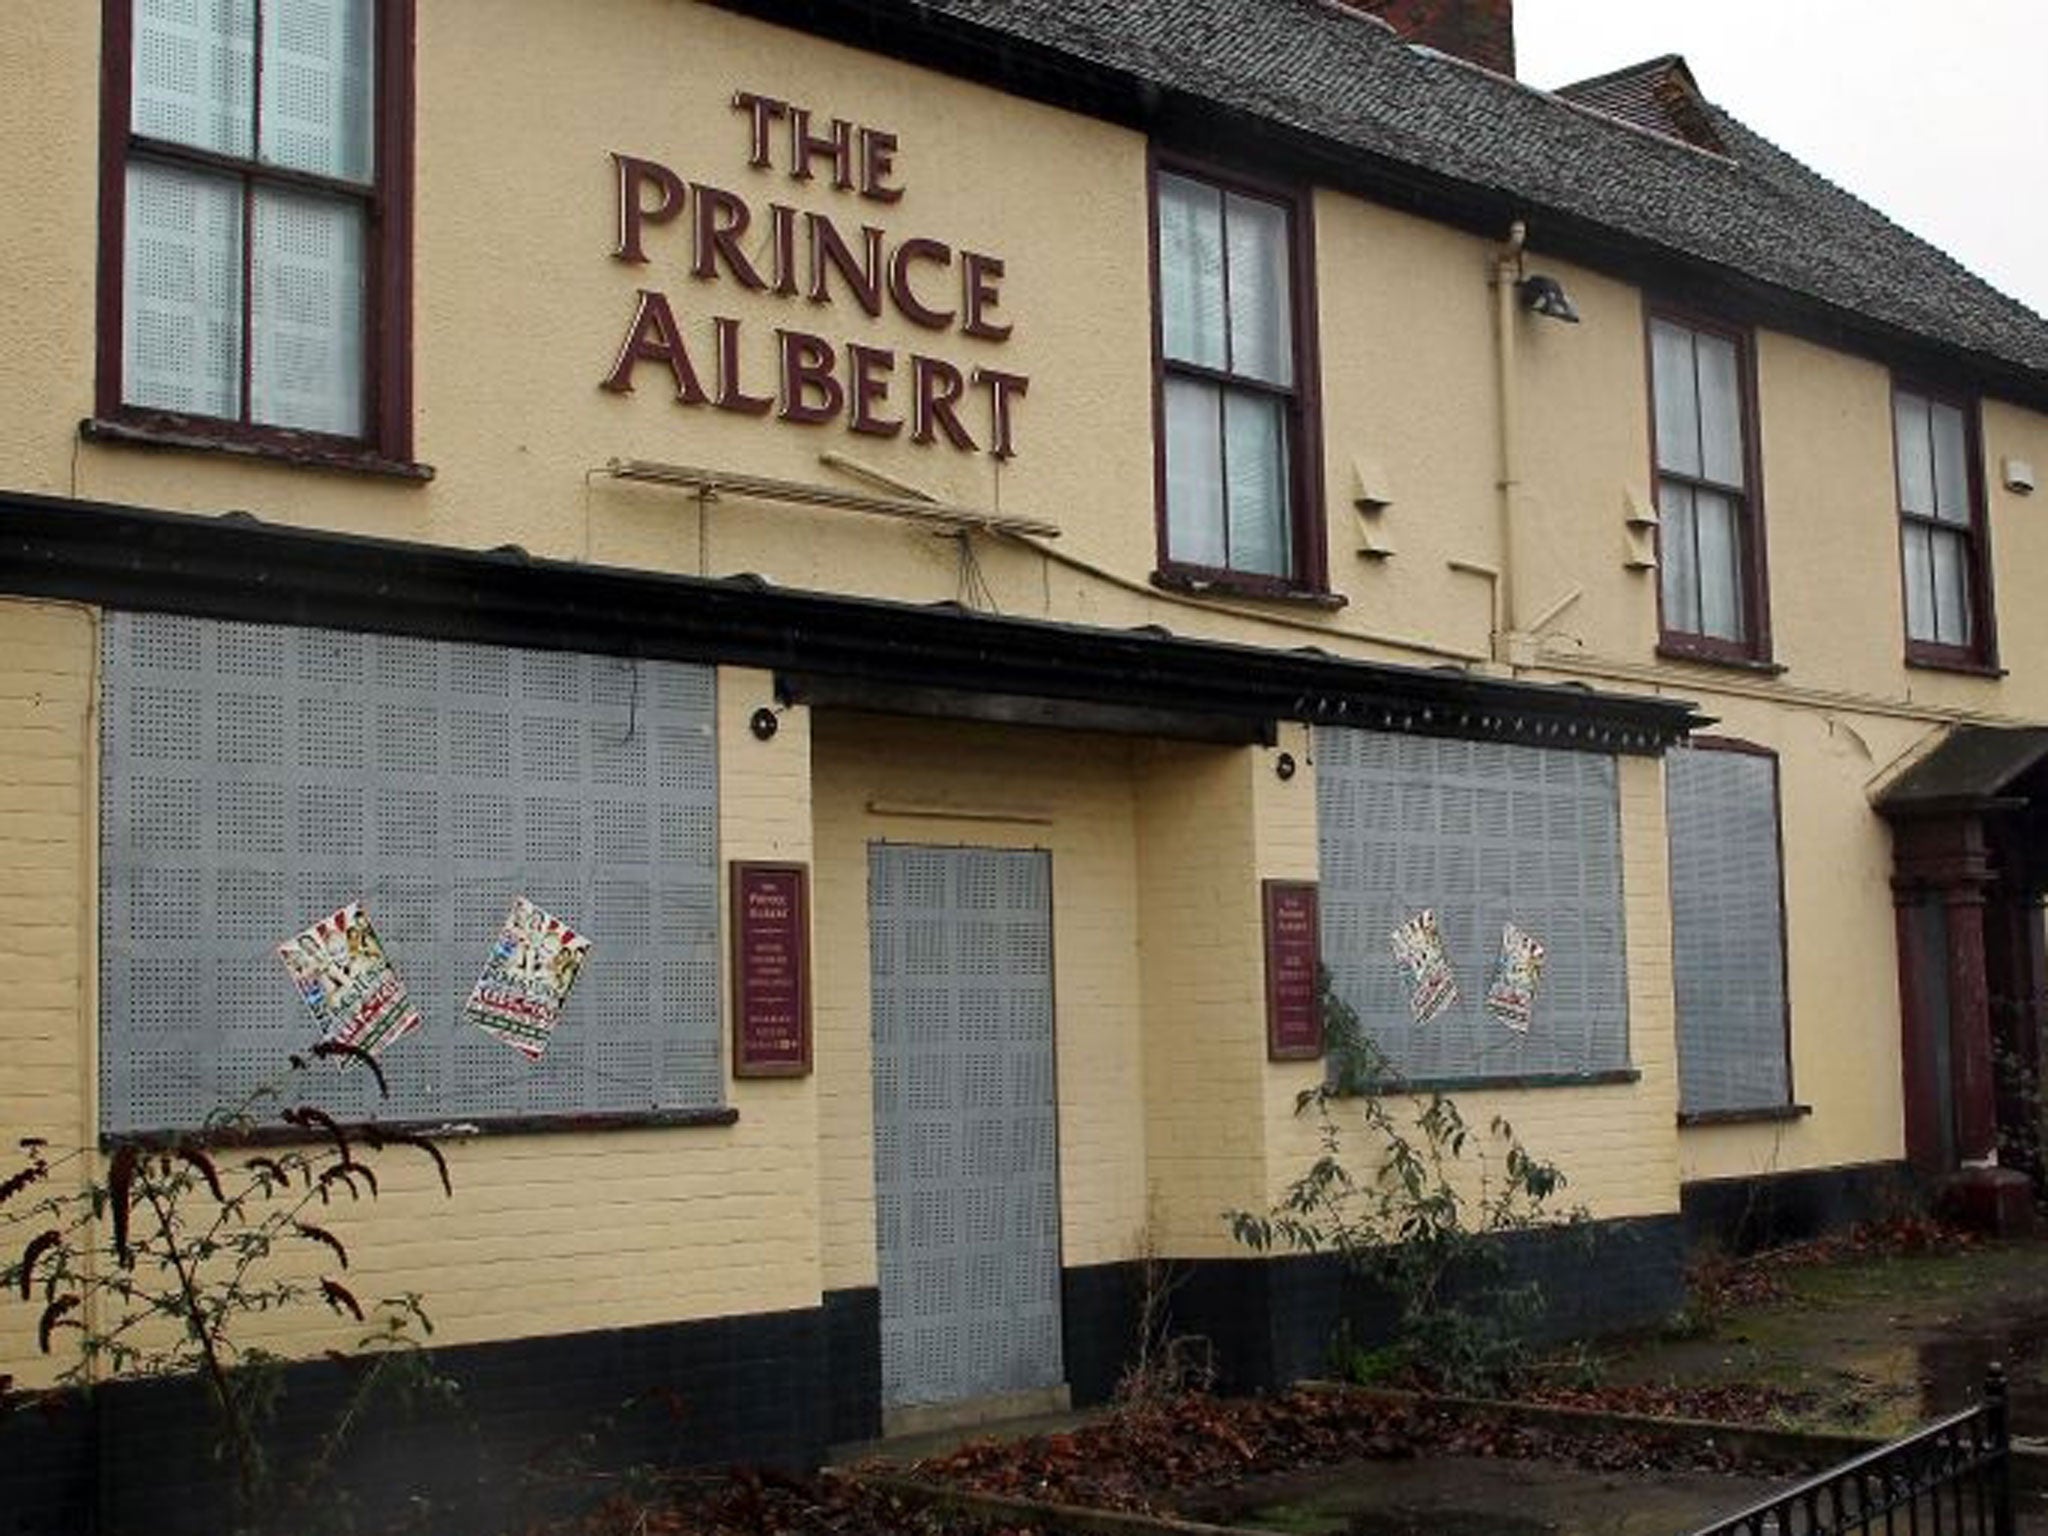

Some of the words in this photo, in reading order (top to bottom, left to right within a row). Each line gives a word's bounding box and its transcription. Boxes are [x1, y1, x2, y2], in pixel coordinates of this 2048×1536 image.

[732, 89, 905, 202] THE
[610, 152, 1013, 342] PRINCE
[600, 289, 1030, 460] ALBERT
